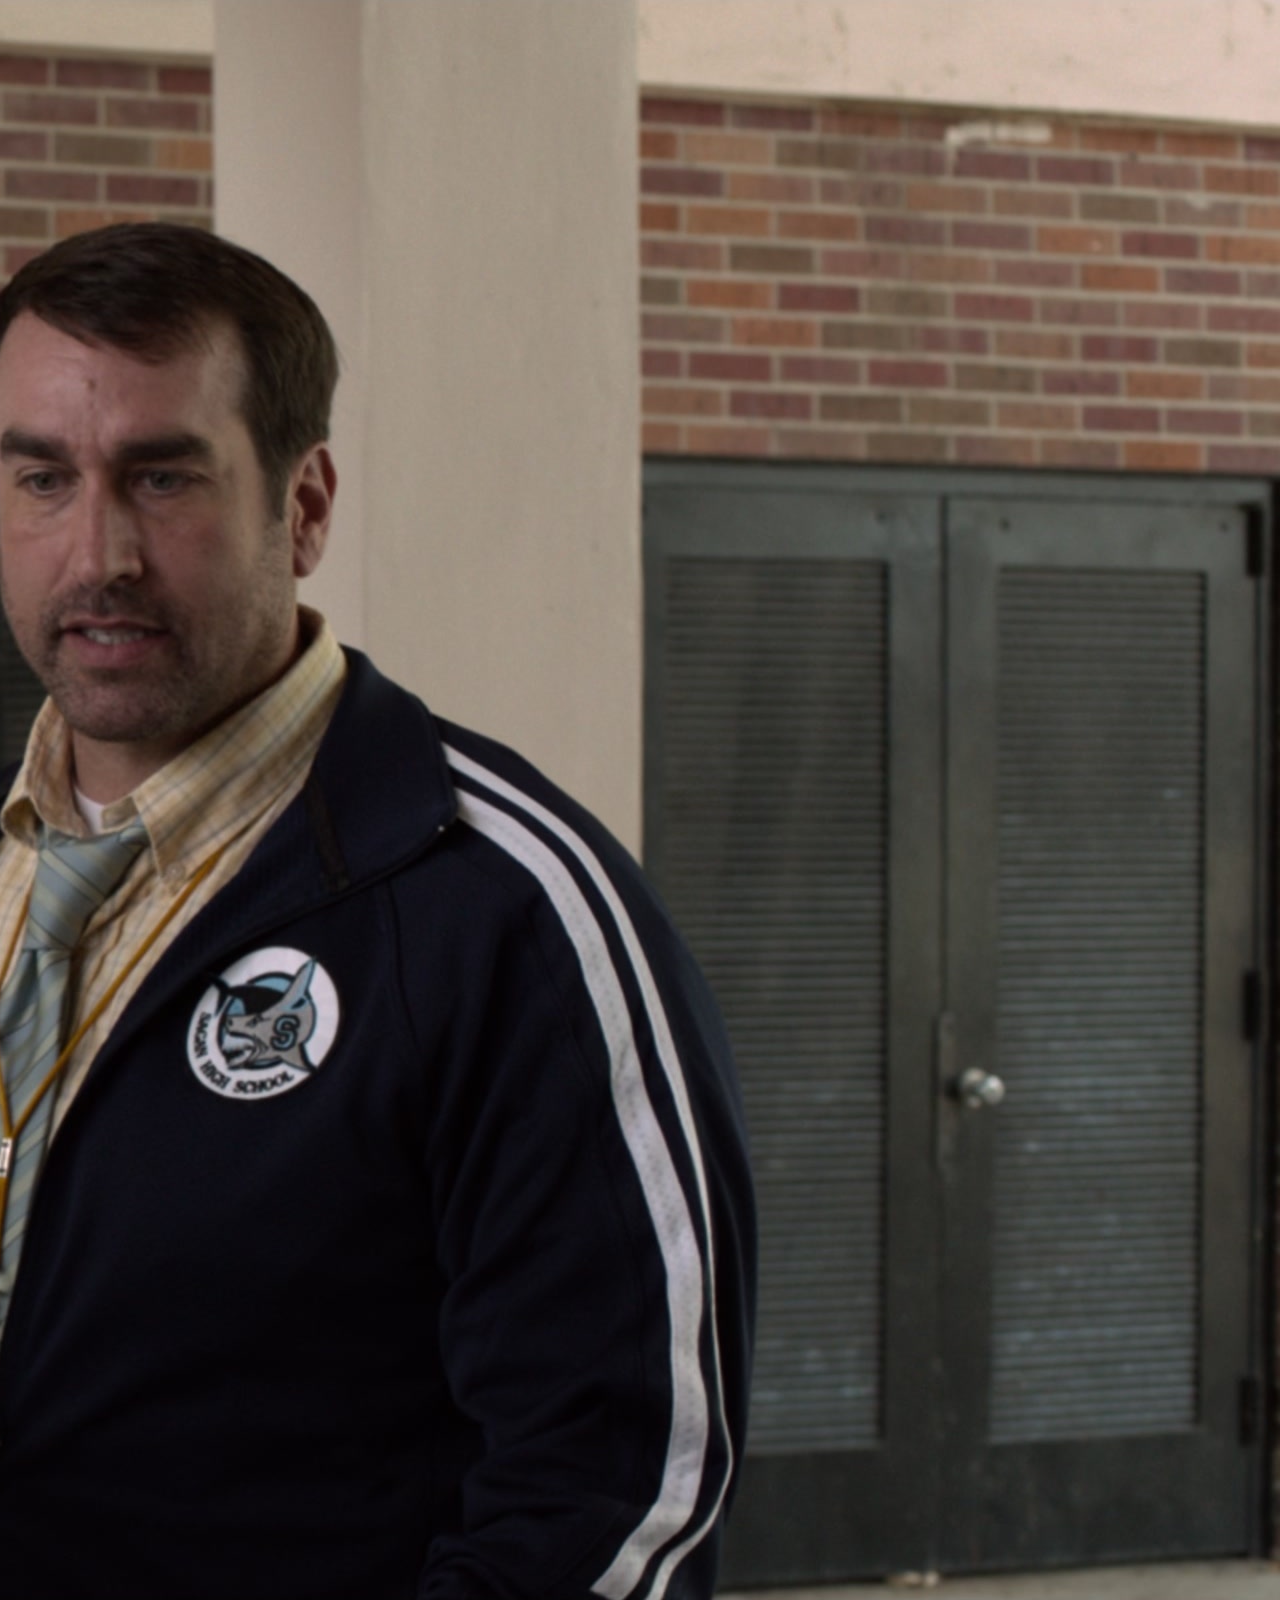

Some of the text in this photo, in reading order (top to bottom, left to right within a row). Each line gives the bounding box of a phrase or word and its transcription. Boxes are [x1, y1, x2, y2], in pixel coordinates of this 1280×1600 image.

[270, 1014, 300, 1051] S
[201, 1061, 231, 1089] HIGH
[233, 1071, 294, 1094] SCHOOL
